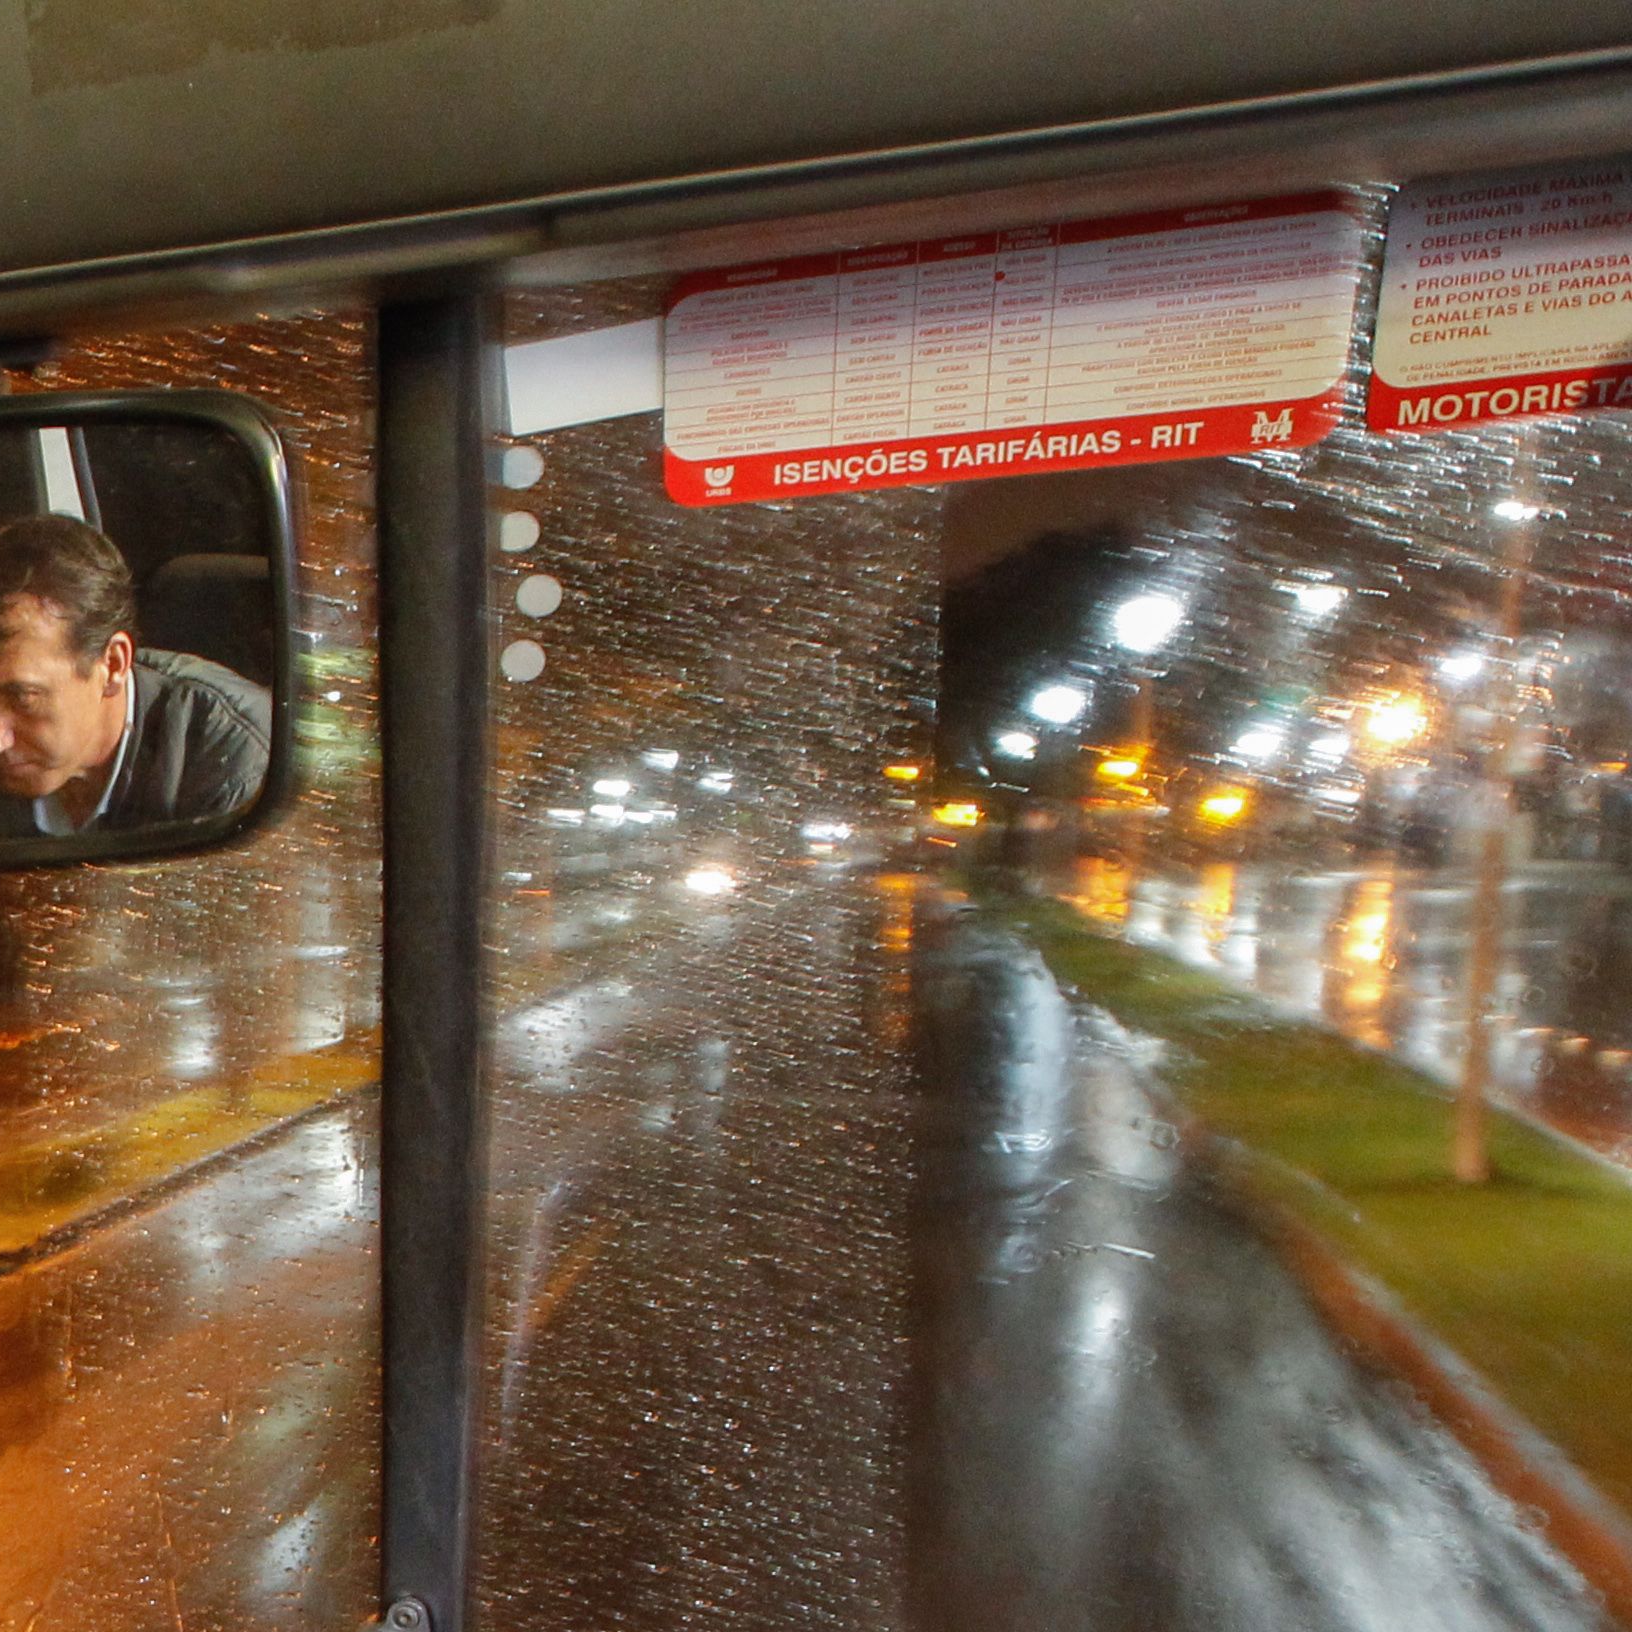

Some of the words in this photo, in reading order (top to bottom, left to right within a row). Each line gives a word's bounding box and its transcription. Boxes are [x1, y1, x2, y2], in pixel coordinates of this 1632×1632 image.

[1421, 226, 1523, 250] OBEDECER
[1418, 253, 1455, 268] DAS
[1461, 245, 1503, 263] VIAS
[1416, 268, 1505, 292] PROIBIDO
[1413, 296, 1441, 310] EM
[1445, 284, 1522, 306] PONTOS
[1528, 280, 1552, 295] DE
[1411, 302, 1518, 327] CANALETAS
[1524, 301, 1535, 313] E
[1541, 294, 1582, 312] VIAS
[1588, 291, 1617, 306] DO
[1409, 325, 1493, 345] CENTRAL
[773, 449, 929, 485] ISENÇÕES
[940, 429, 1122, 470] TARIFÁRIAS
[1150, 421, 1205, 449] RIT
